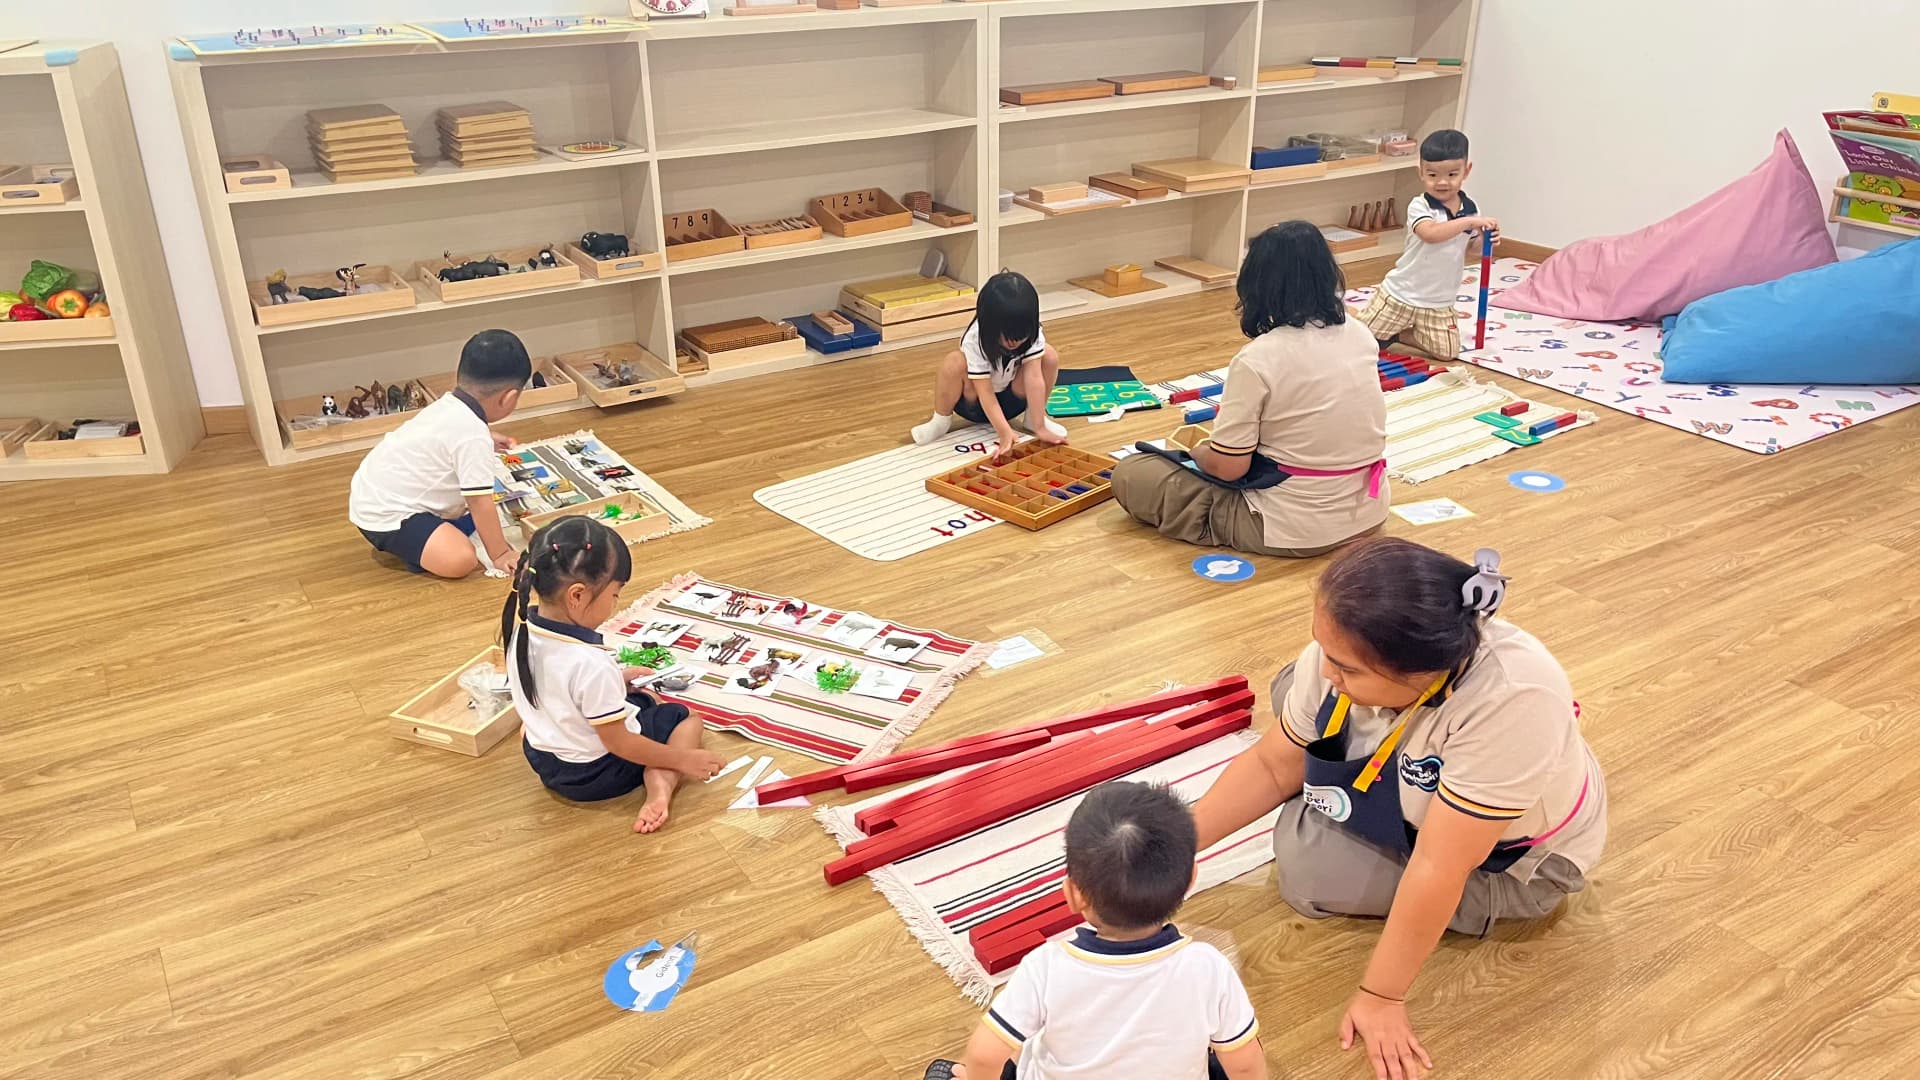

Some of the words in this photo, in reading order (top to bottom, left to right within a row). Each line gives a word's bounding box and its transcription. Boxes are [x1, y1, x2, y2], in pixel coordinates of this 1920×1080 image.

[843, 196, 849, 206] 2
[857, 194, 863, 204] 3
[868, 192, 874, 202] 4
[672, 217, 678, 229] 7
[687, 215, 694, 227] 8
[701, 213, 708, 225] 9
